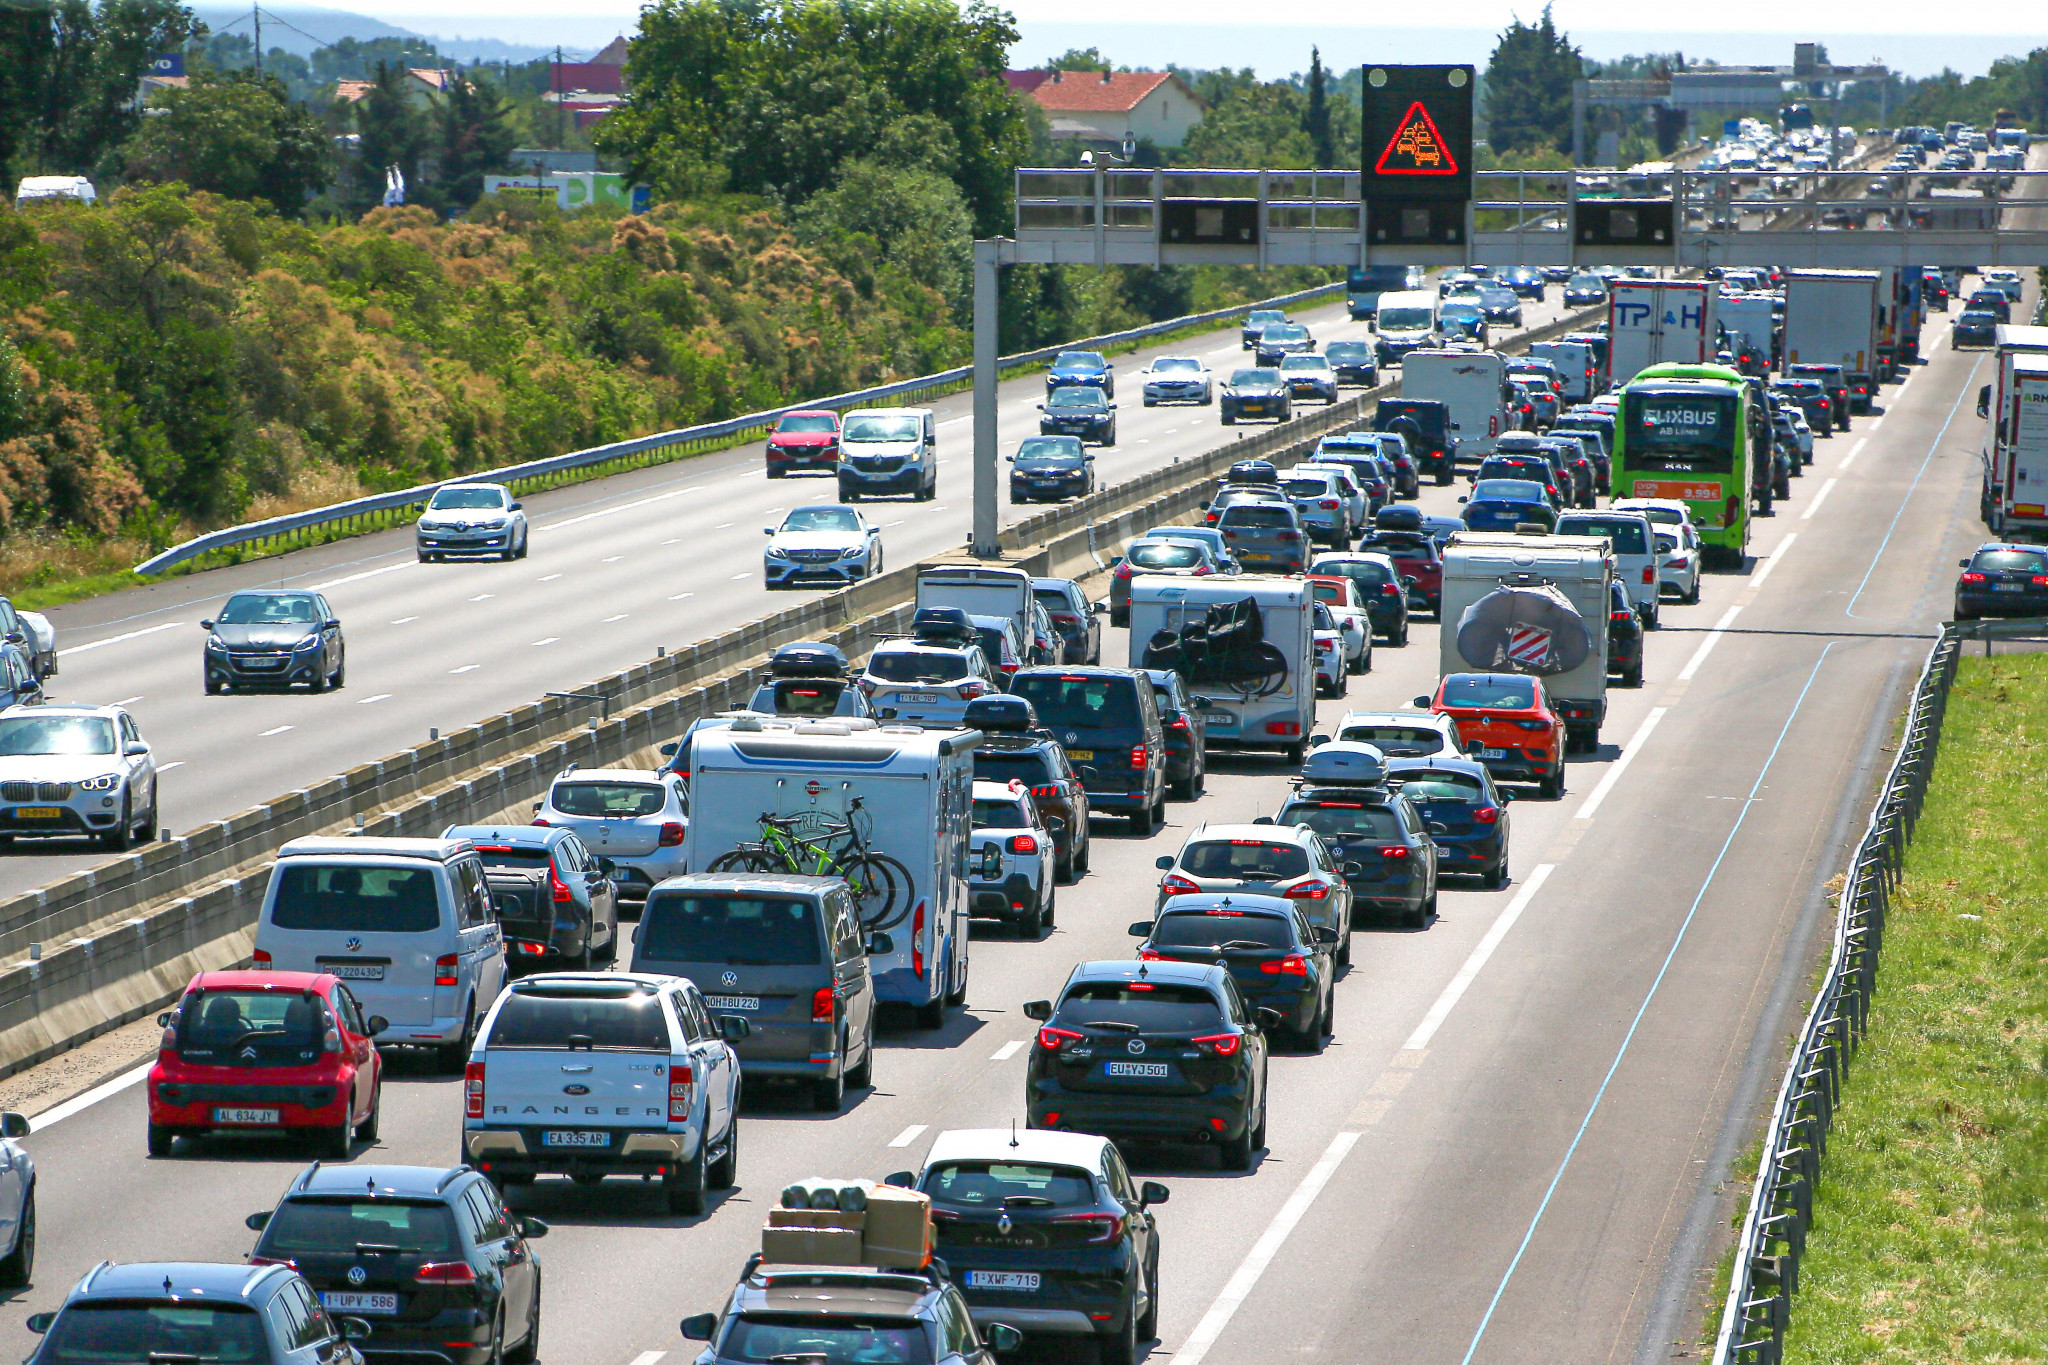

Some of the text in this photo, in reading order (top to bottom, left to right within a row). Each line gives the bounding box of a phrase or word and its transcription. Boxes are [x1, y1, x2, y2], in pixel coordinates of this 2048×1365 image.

[741, 998, 758, 1009] 226
[1132, 1064, 1146, 1076] YJ
[1147, 1065, 1168, 1077] 501
[492, 1105, 661, 1117] RANGER
